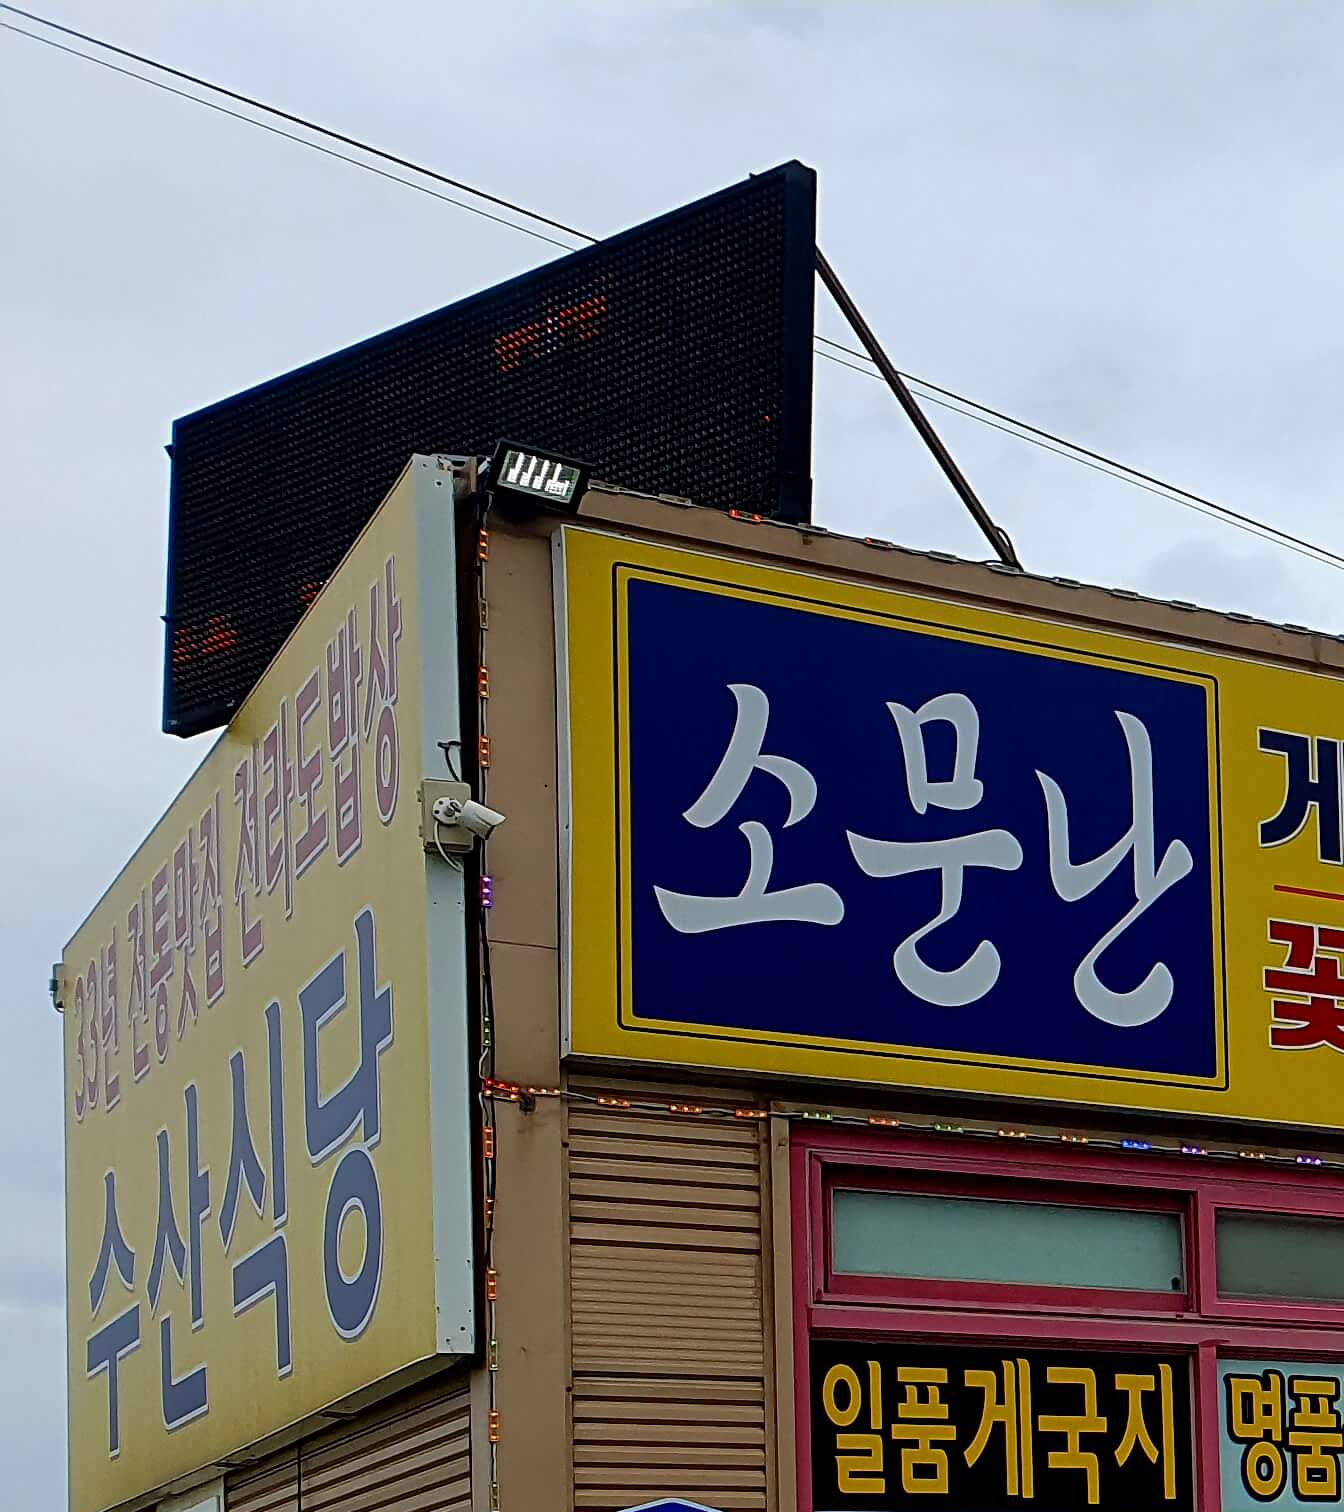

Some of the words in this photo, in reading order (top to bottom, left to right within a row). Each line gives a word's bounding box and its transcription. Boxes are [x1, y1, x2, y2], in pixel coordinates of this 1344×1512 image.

[73, 923, 121, 1123] 33년
[126, 788, 223, 1070] 전통맛집
[234, 552, 403, 969] 전라도밥상
[652, 683, 1193, 1028] 소문난
[87, 908, 393, 1459] 수산식당
[822, 1359, 1176, 1504] 일품게국지
